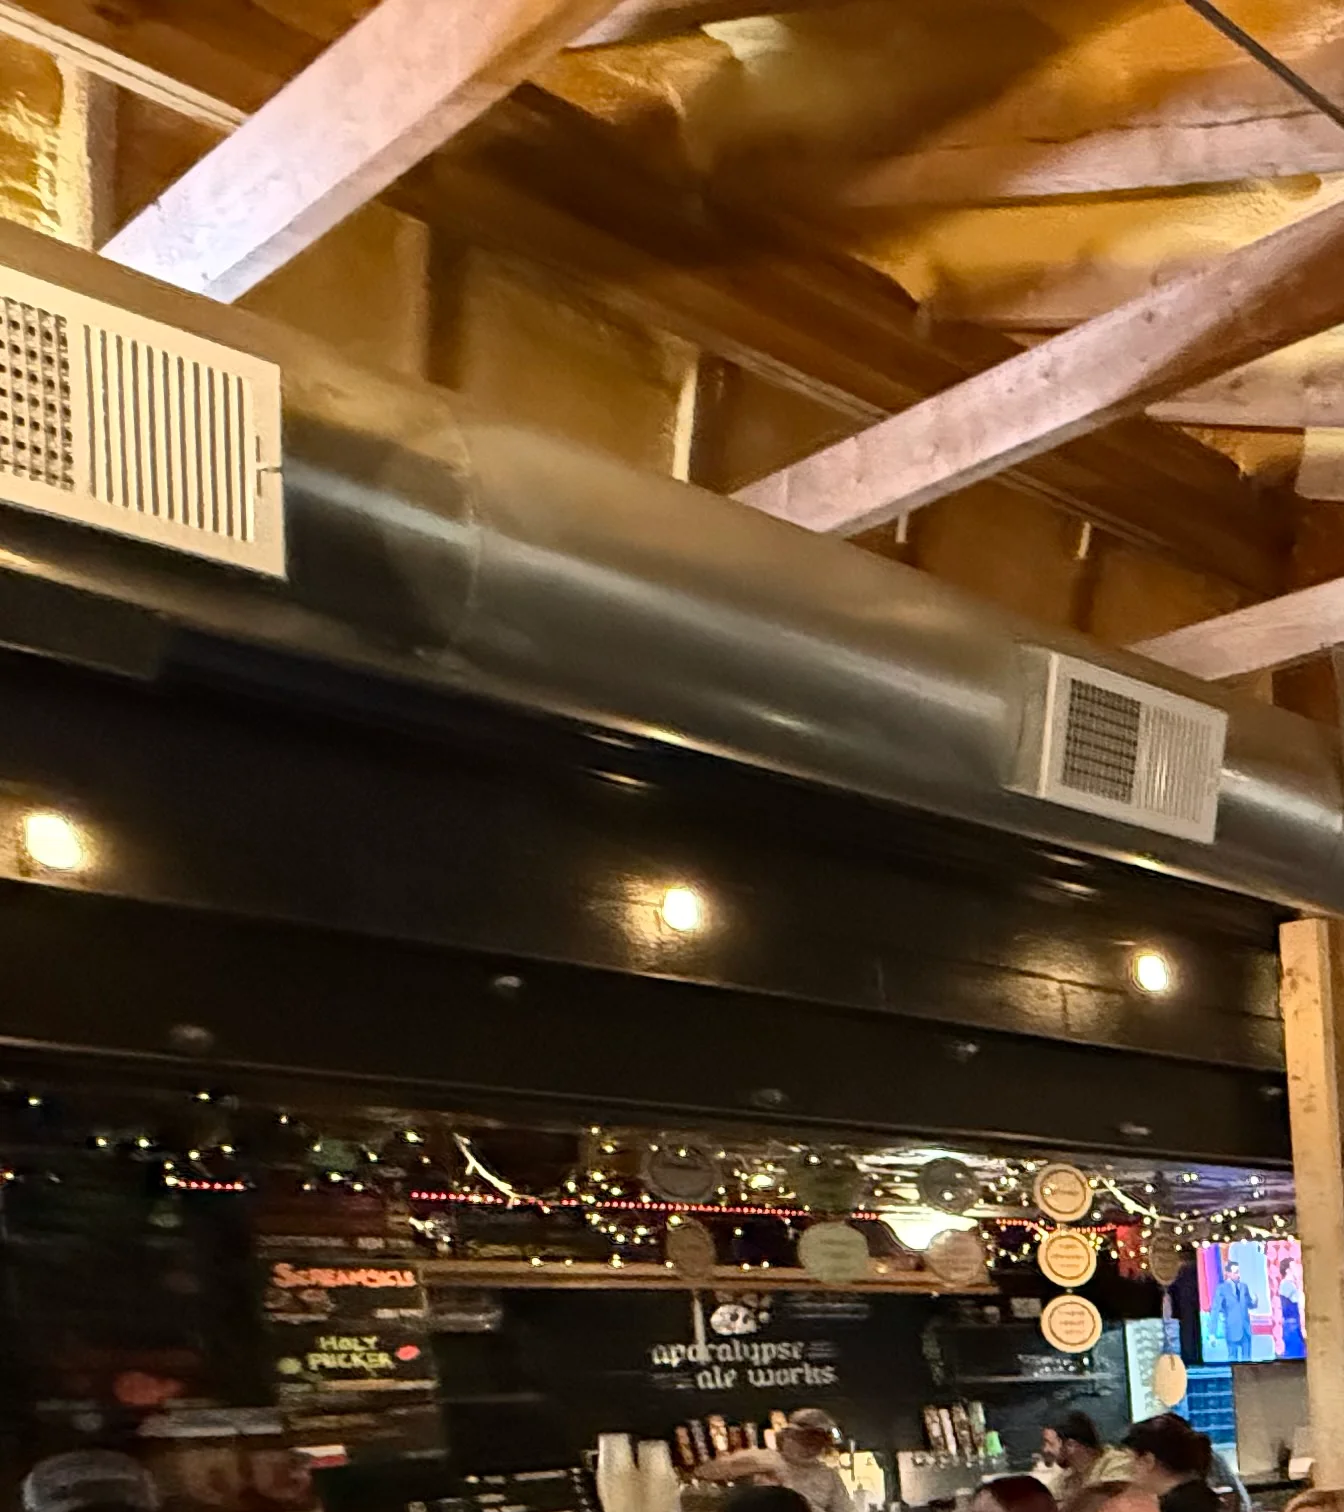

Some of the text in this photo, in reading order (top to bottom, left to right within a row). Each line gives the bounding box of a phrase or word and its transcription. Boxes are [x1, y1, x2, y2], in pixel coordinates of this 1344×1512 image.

[319, 1336, 379, 1351] HOLY
[306, 1352, 397, 1371] PUCKER
[696, 1362, 839, 1389] ale works
